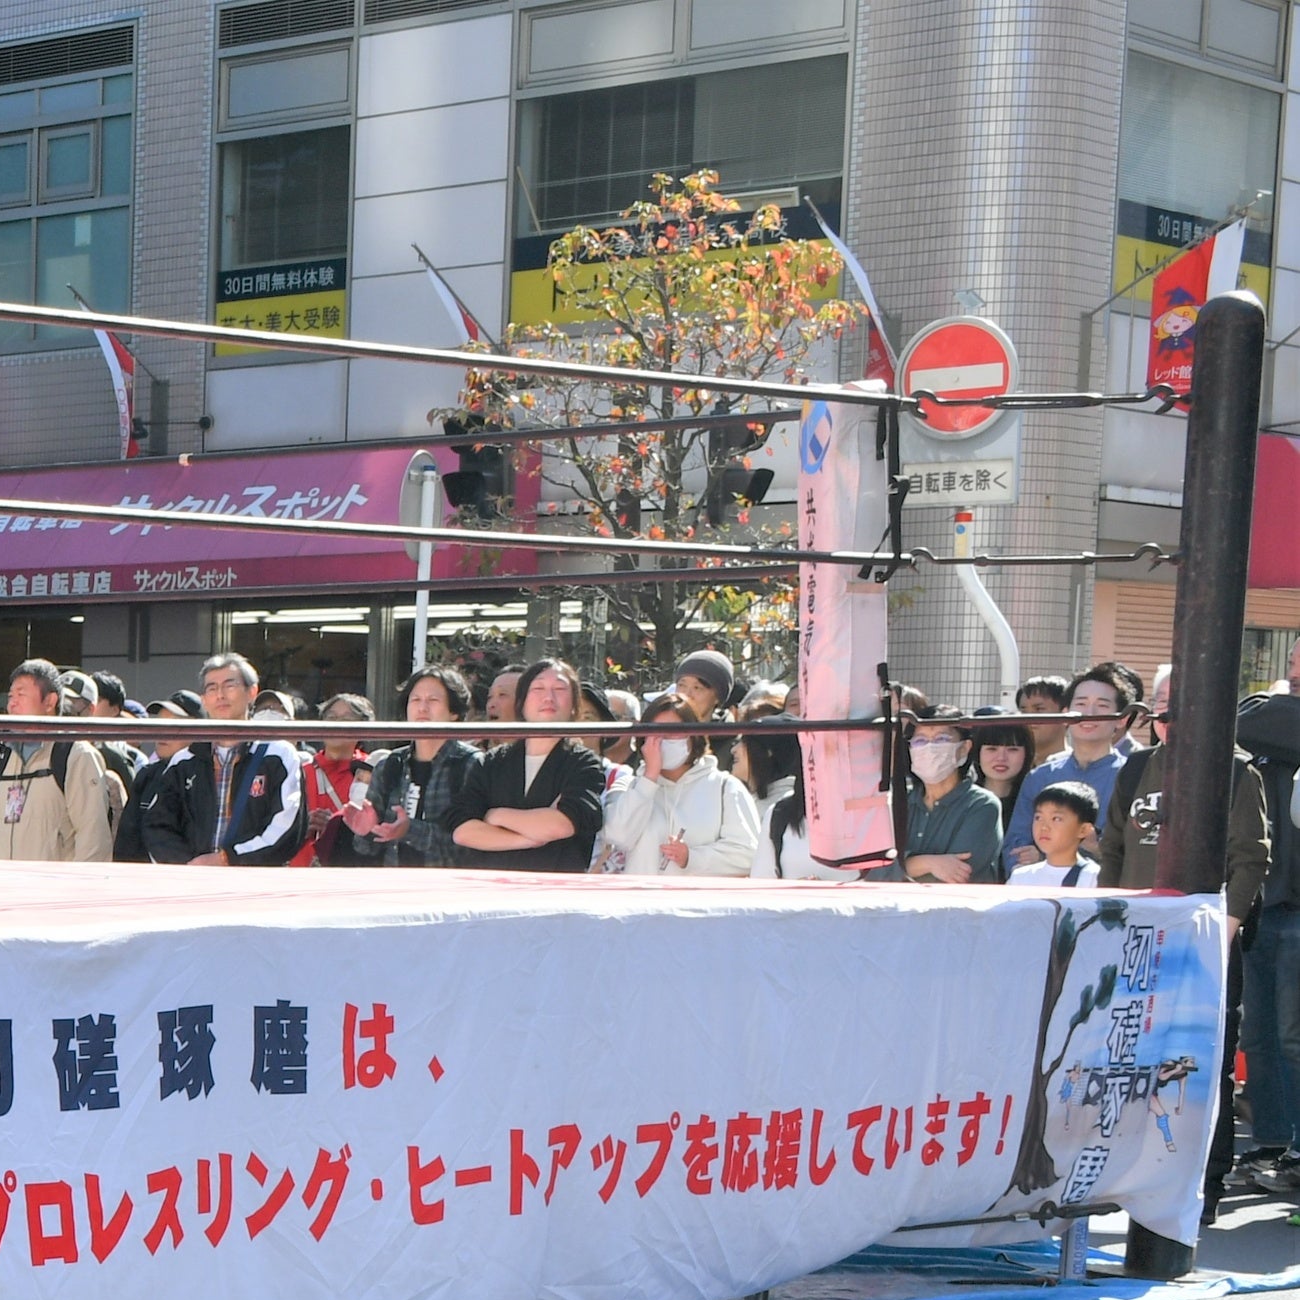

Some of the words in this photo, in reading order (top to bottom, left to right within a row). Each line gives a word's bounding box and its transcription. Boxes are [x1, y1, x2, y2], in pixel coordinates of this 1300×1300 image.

[224, 265, 335, 295] 30日間無料体験
[908, 469, 1008, 495] 自転車を除く
[109, 483, 368, 537] サイクルスポット
[133, 566, 238, 592] サイクルスポット
[1059, 924, 1155, 1205] 切磋琢磨
